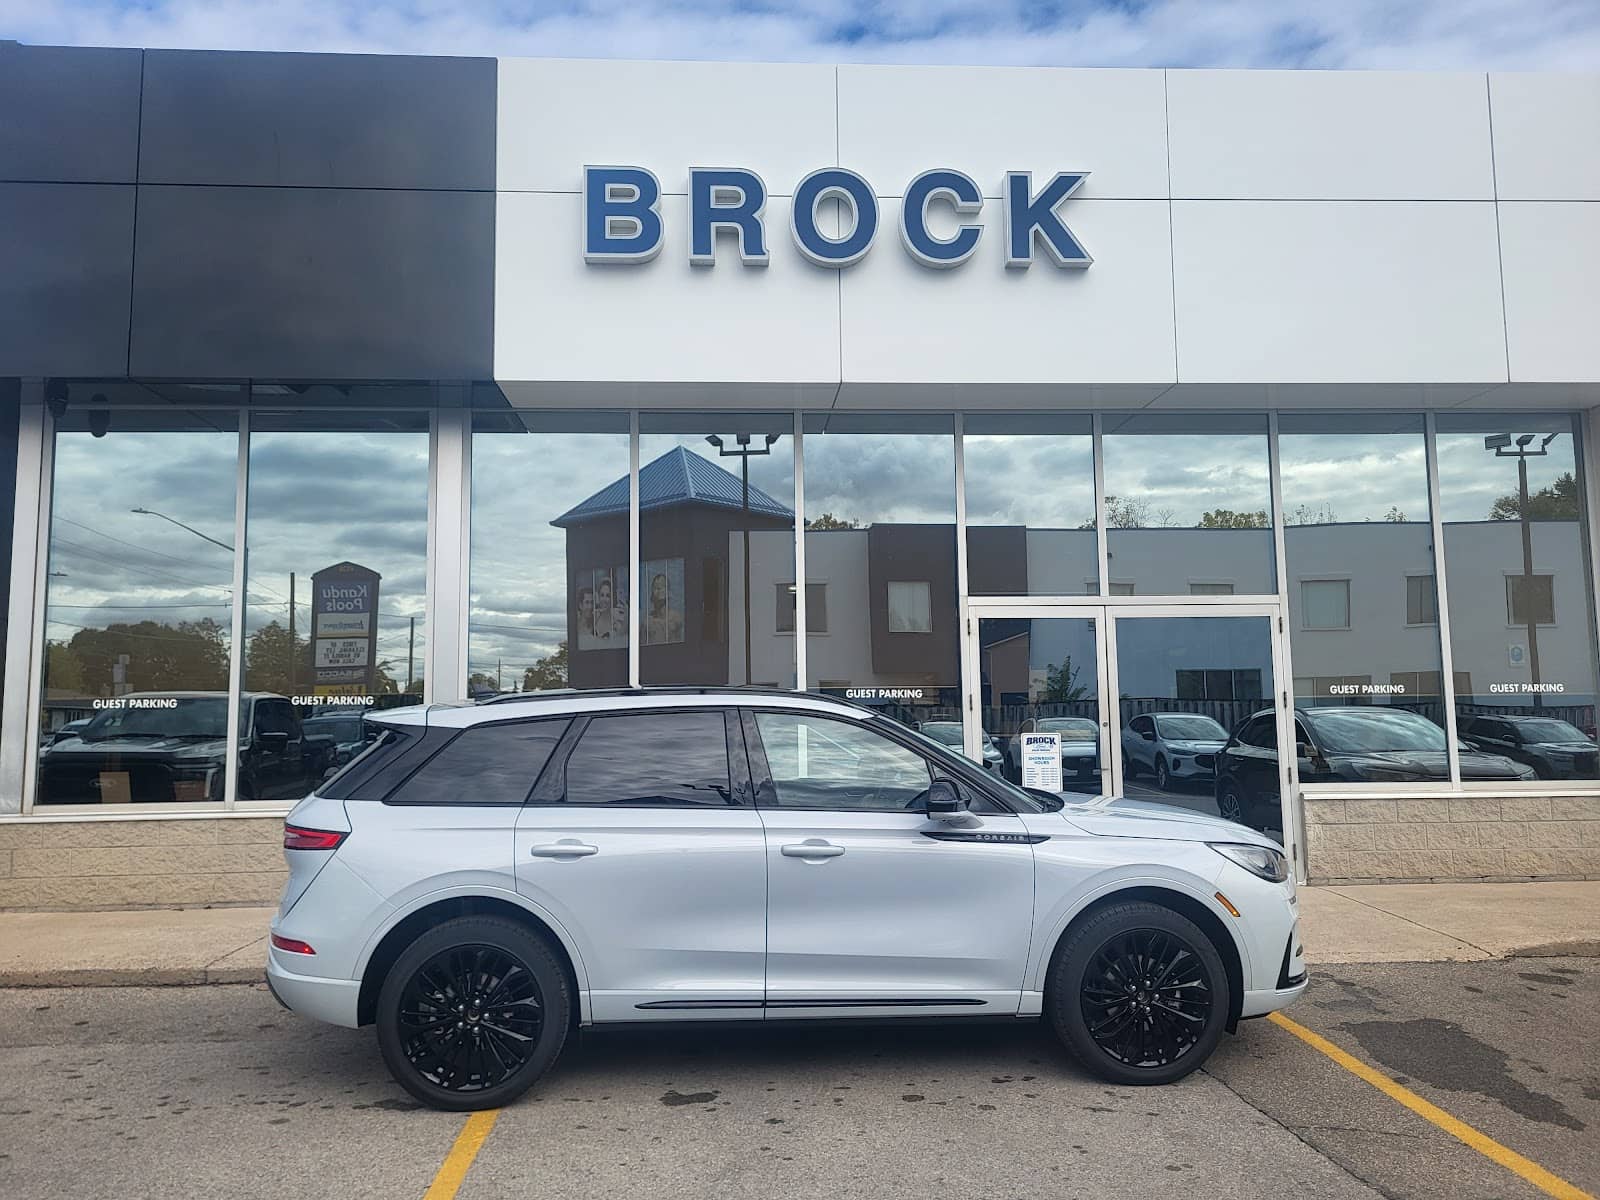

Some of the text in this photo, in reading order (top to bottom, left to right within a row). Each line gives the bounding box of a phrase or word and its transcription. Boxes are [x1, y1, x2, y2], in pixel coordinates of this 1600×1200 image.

[583, 165, 1094, 269] BROCK
[1330, 684, 1405, 694] GUEST PARKING
[1490, 683, 1565, 693] GUEST PARKING
[845, 689, 923, 698] GUEST PARKING
[93, 698, 178, 709] GUEST PARKING
[291, 696, 374, 705] GUEST PARKING
[1026, 736, 1057, 745] BROCK
